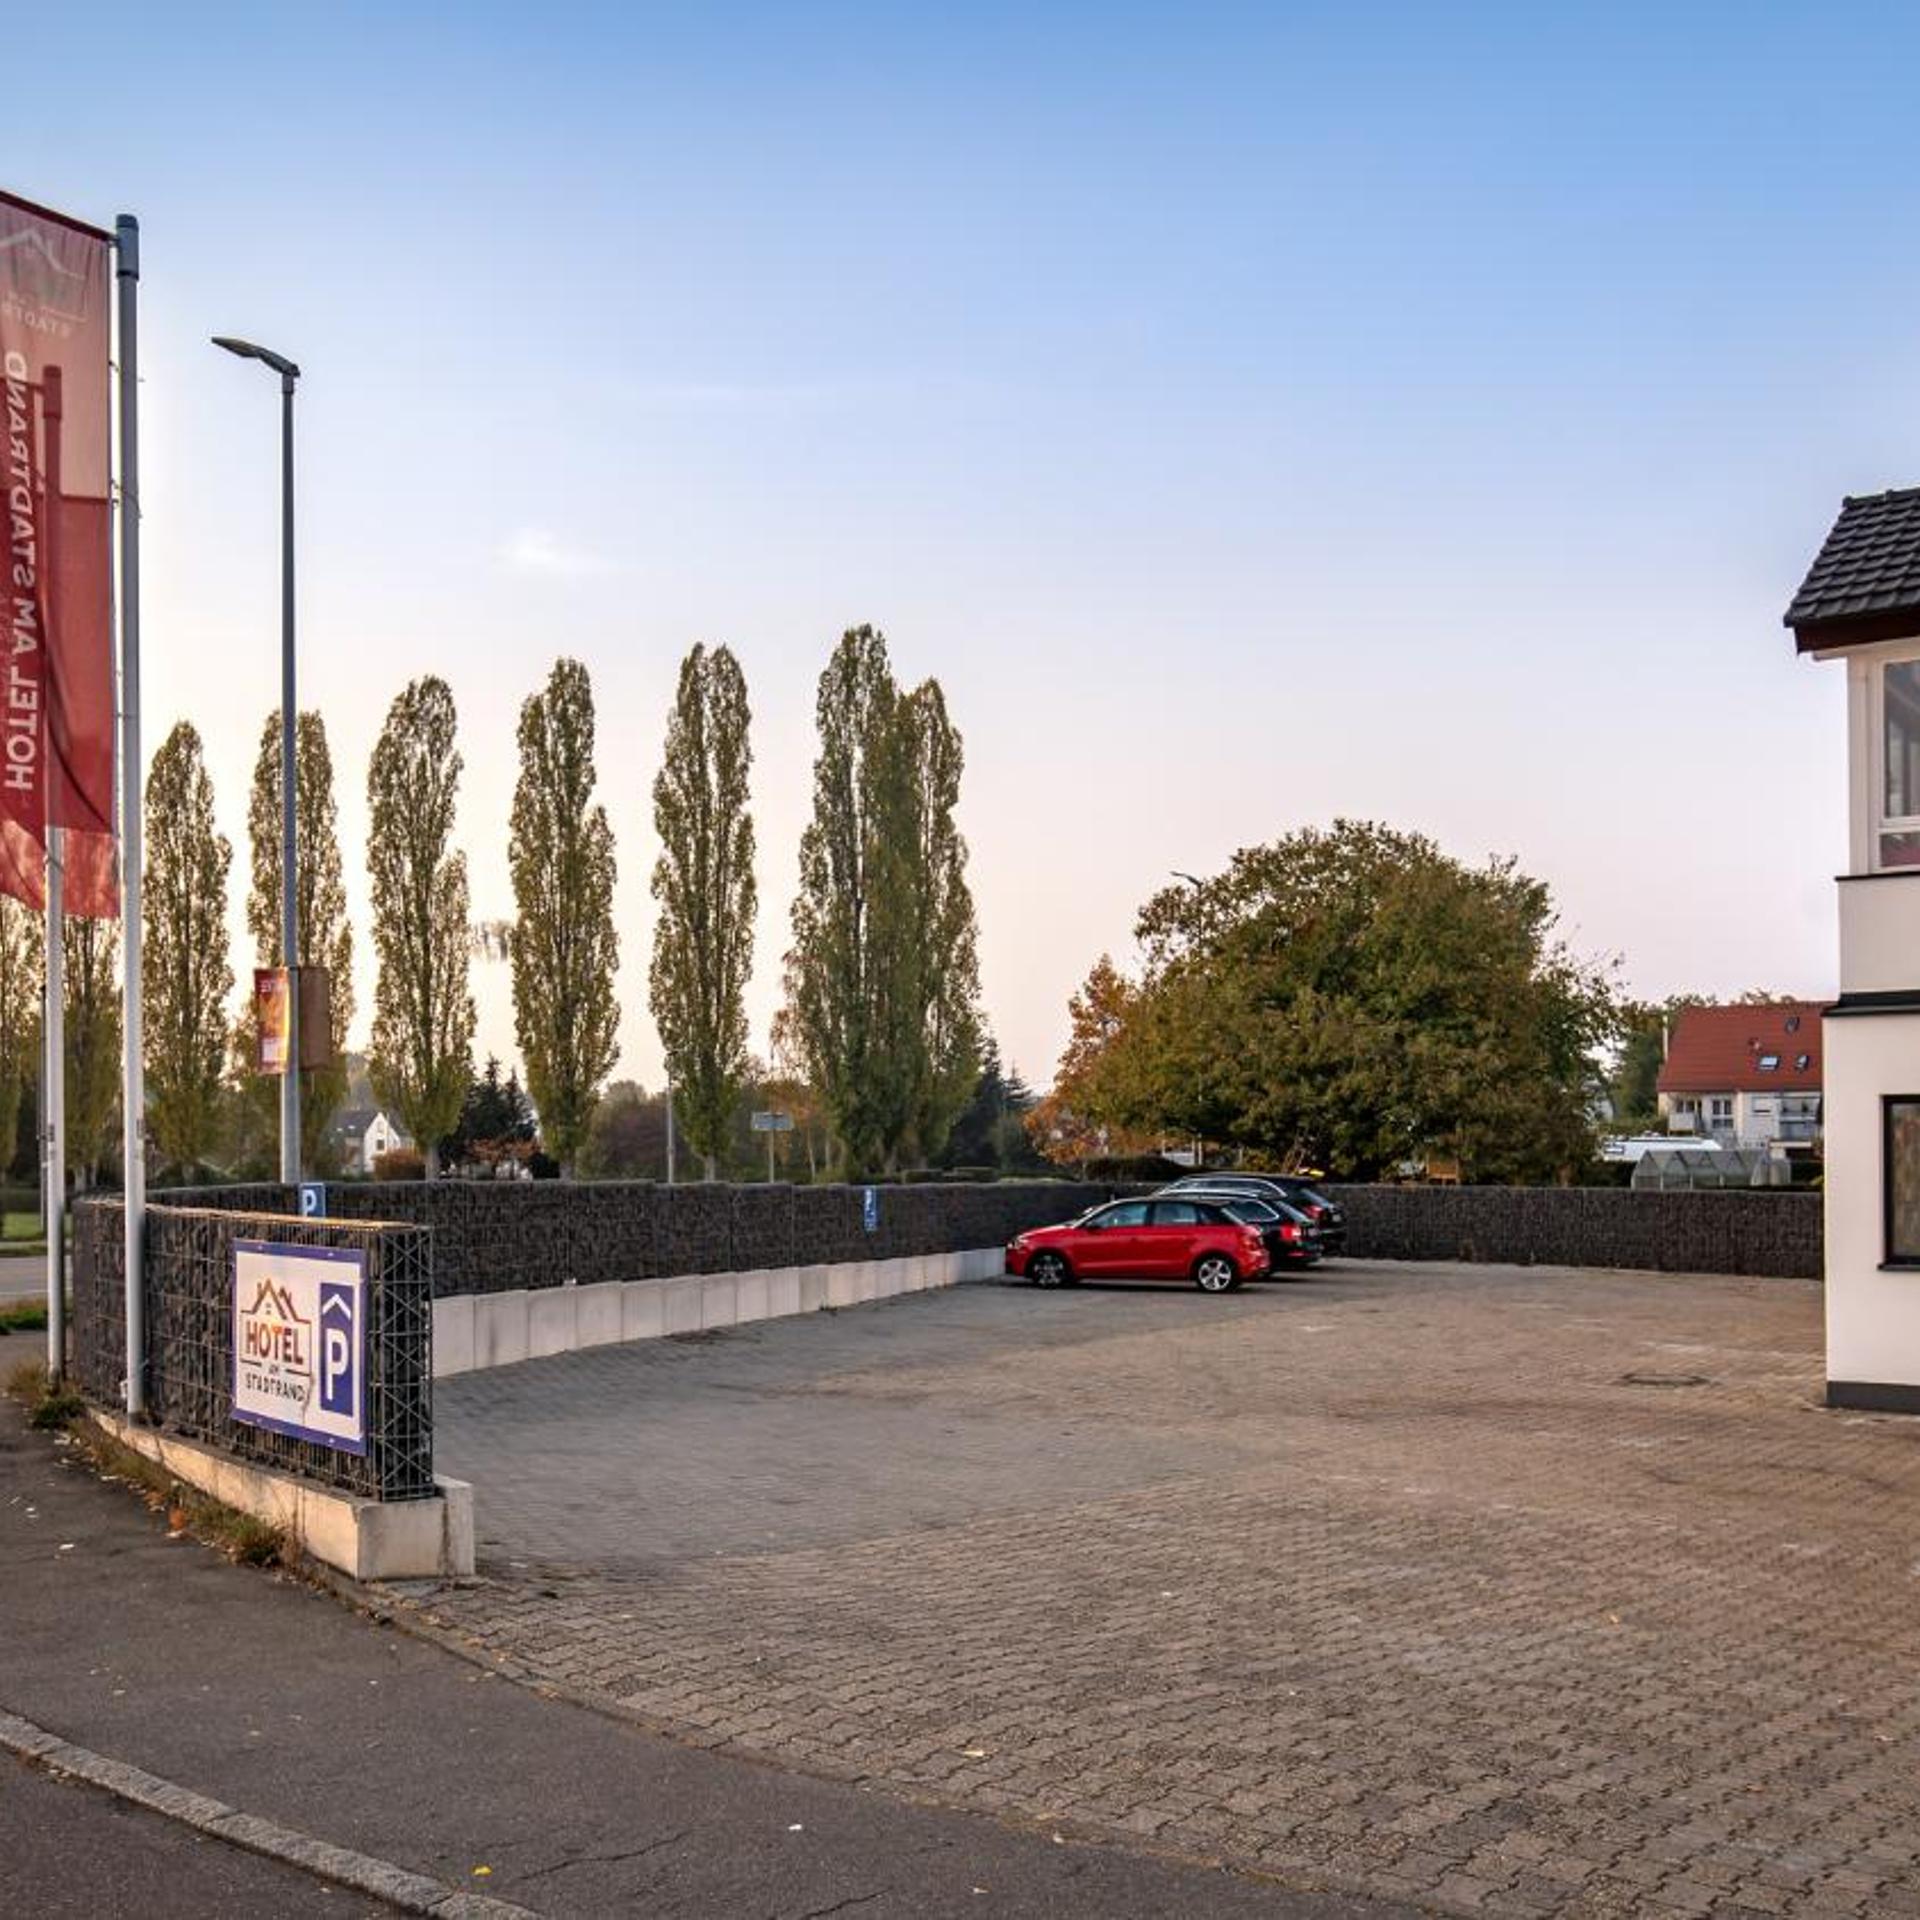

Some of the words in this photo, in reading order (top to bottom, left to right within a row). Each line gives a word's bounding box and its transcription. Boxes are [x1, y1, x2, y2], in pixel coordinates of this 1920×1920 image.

[302, 1189, 317, 1217] P
[246, 1320, 304, 1365] HOTEL
[326, 1328, 348, 1400] P
[245, 1372, 305, 1403] STADTRAND
